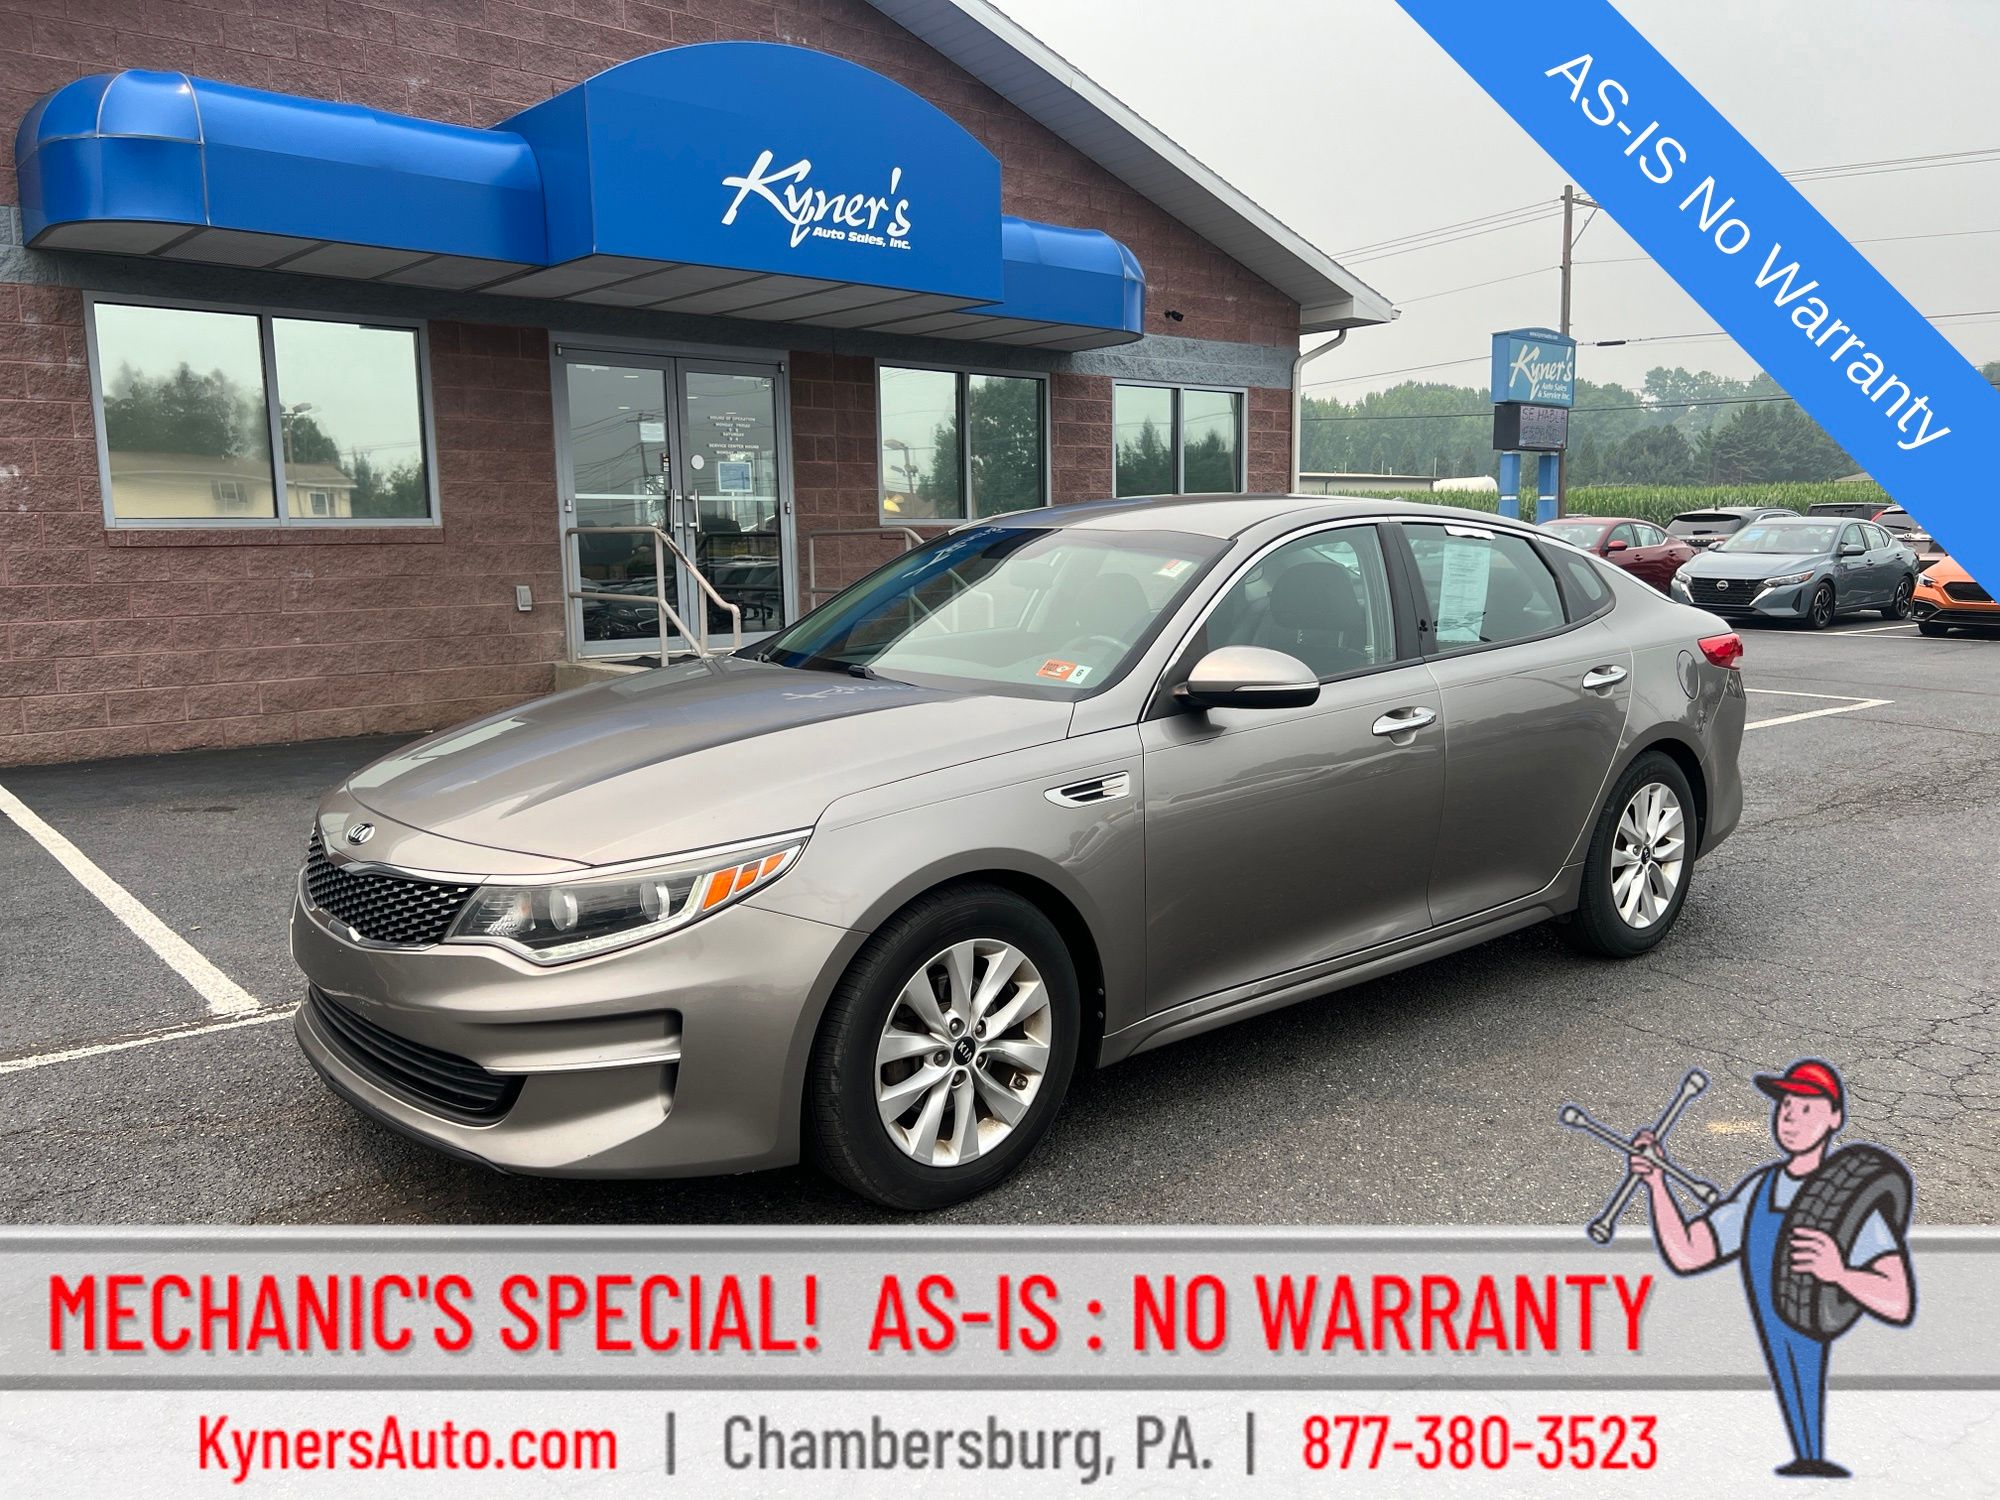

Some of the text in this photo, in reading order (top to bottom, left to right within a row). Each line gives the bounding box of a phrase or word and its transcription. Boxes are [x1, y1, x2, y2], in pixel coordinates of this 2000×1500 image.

[721, 150, 911, 248] Kyner's
[812, 226, 911, 249] Auto Sales, Inc.
[1509, 344, 1572, 400] Kyner's
[1541, 382, 1568, 392] Auto Sales
[1543, 391, 1561, 399] Service
[1522, 407, 1534, 421] SE
[957, 1041, 972, 1062] KIA
